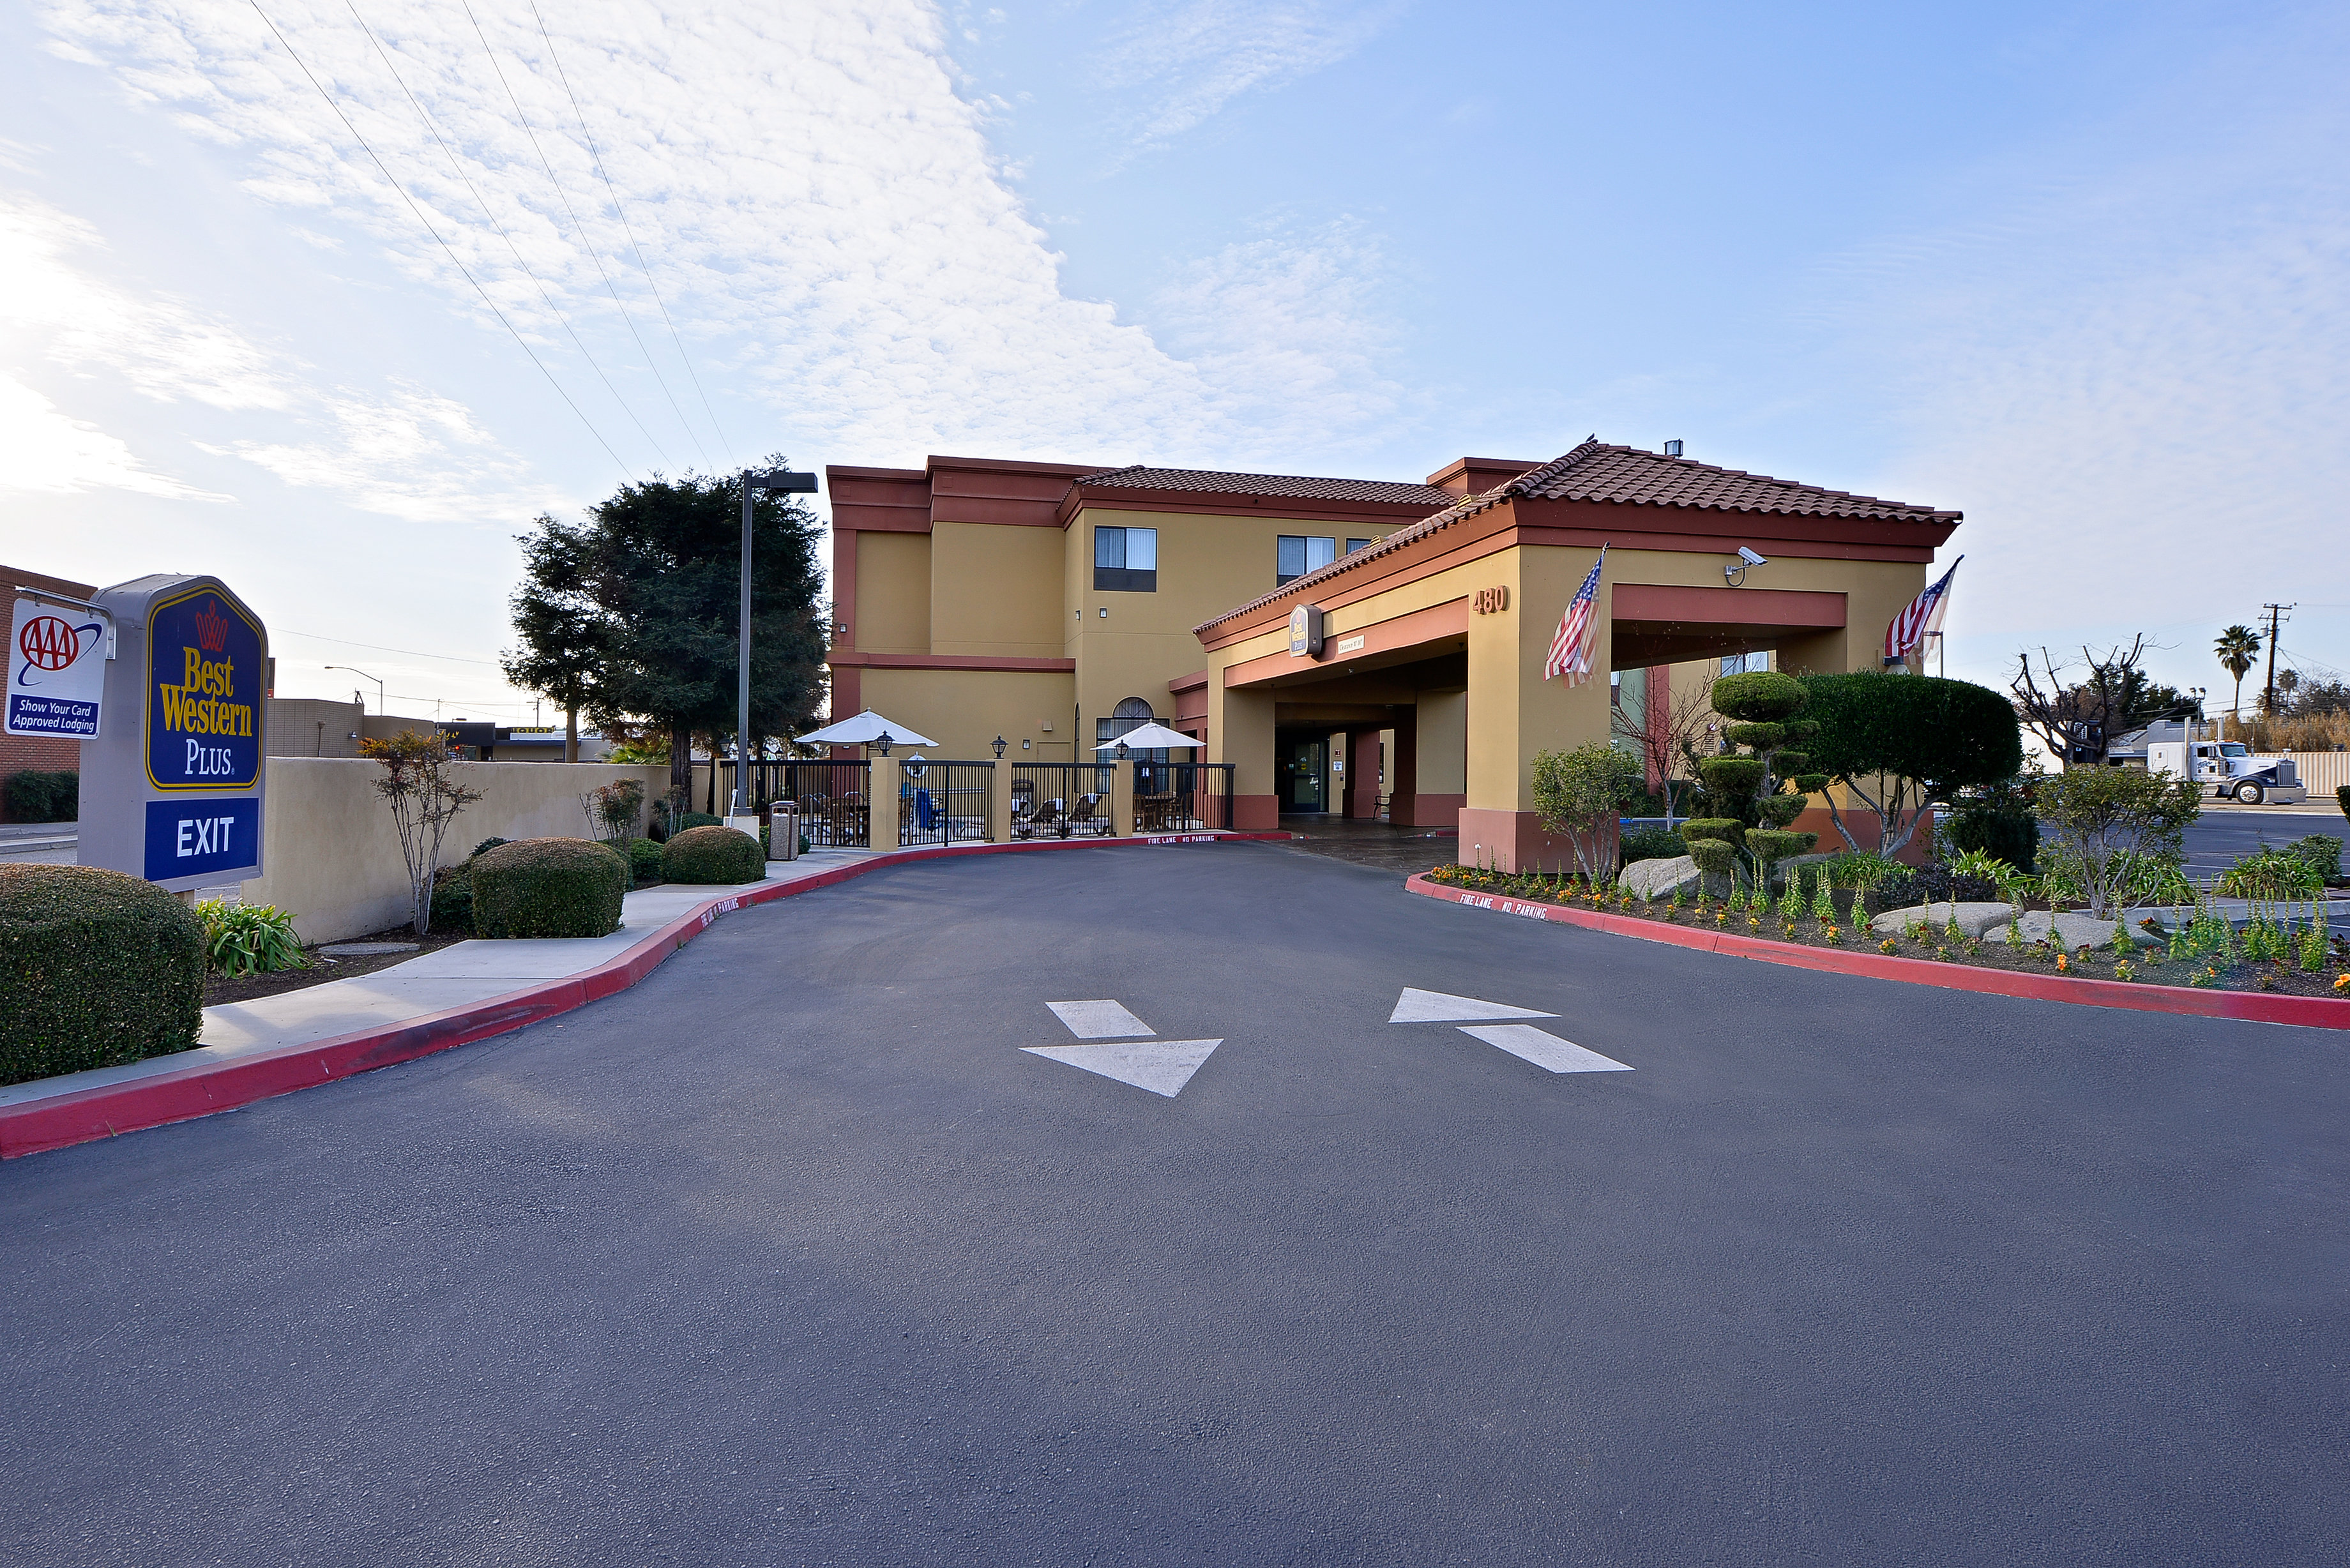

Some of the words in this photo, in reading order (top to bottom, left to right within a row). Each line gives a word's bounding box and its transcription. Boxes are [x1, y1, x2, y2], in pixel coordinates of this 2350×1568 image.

[1473, 585, 1506, 614] 480
[22, 615, 77, 670] AAA
[183, 646, 234, 697] Best
[19, 699, 47, 712] Show
[50, 702, 70, 715] Your
[72, 705, 91, 716] Card
[160, 683, 252, 737] Western
[12, 714, 61, 728] Approved
[61, 717, 95, 733] Lodging
[177, 817, 234, 857] EXIT
[717, 898, 739, 914] PARKING
[1459, 893, 1476, 906] FIRE
[1474, 896, 1494, 909] LANE
[1501, 901, 1513, 913] NO
[1515, 903, 1547, 919] PARKING
